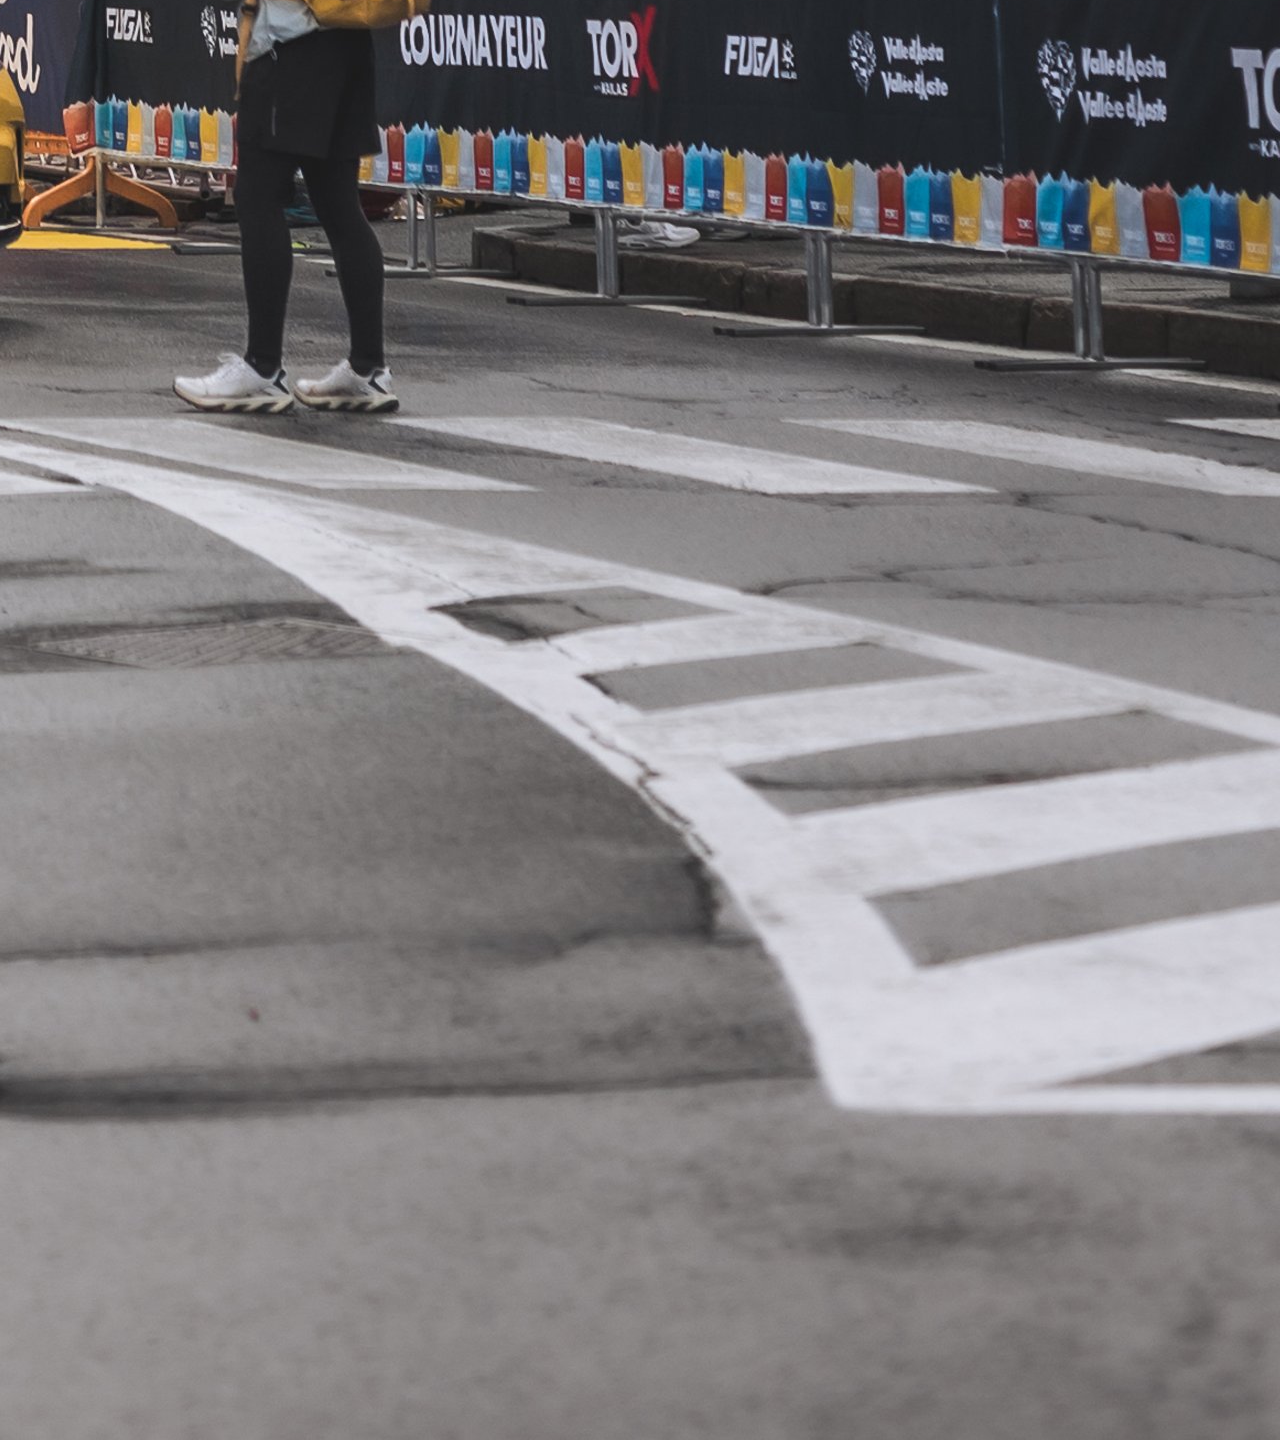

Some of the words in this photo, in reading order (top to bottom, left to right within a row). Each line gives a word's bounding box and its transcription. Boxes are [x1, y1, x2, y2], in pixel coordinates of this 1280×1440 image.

[106, 7, 144, 43] FUGA
[400, 13, 549, 71] COURMAYEUR
[586, 4, 660, 94] TORX
[724, 33, 779, 79] FUGA
[1081, 46, 1116, 82] Valle
